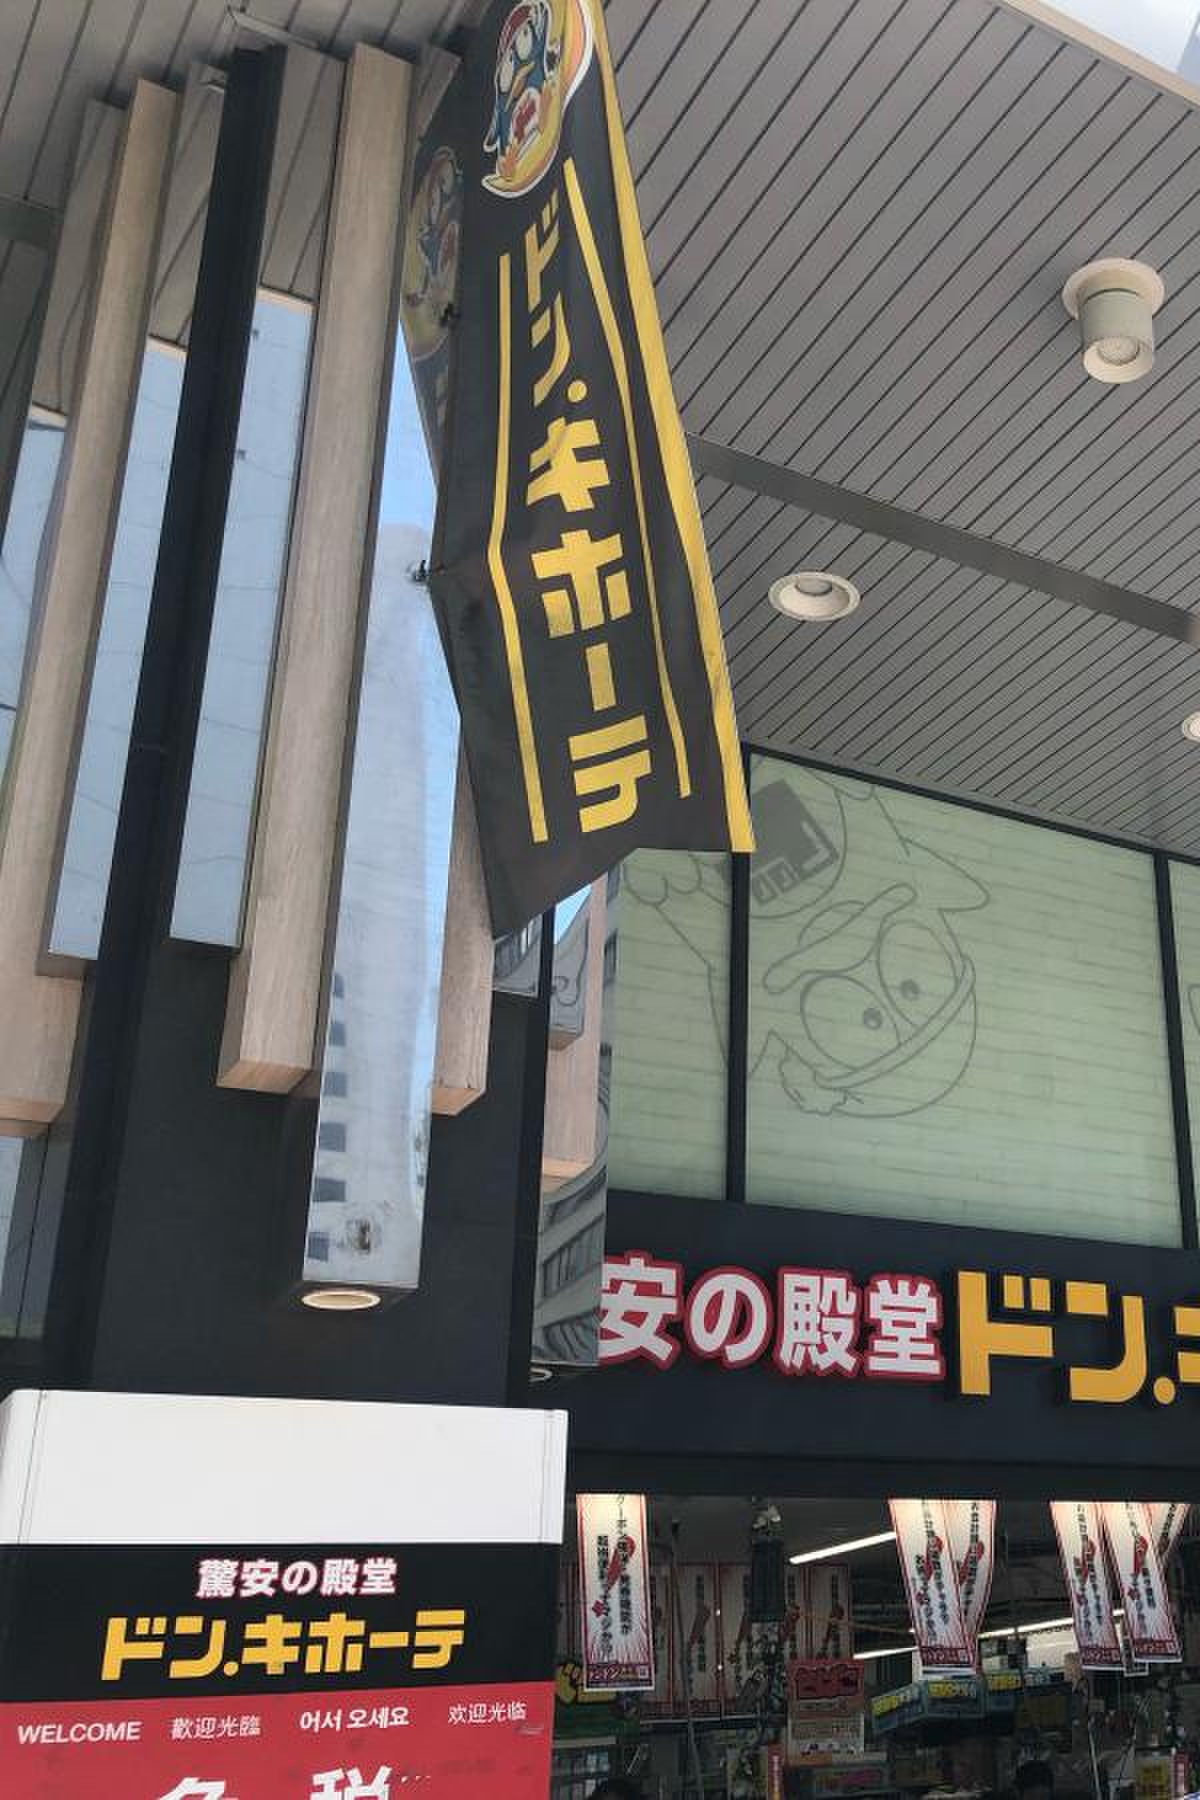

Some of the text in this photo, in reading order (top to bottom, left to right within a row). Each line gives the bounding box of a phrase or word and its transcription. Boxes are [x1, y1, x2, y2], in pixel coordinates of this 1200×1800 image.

[596, 1255, 943, 1377] 安の殿堂
[196, 1556, 398, 1598] 驚安の殿堂
[299, 1706, 410, 1732] 어서 오세요
[447, 1701, 527, 1725] 欢迎光临
[17, 1720, 142, 1745] WELCOME
